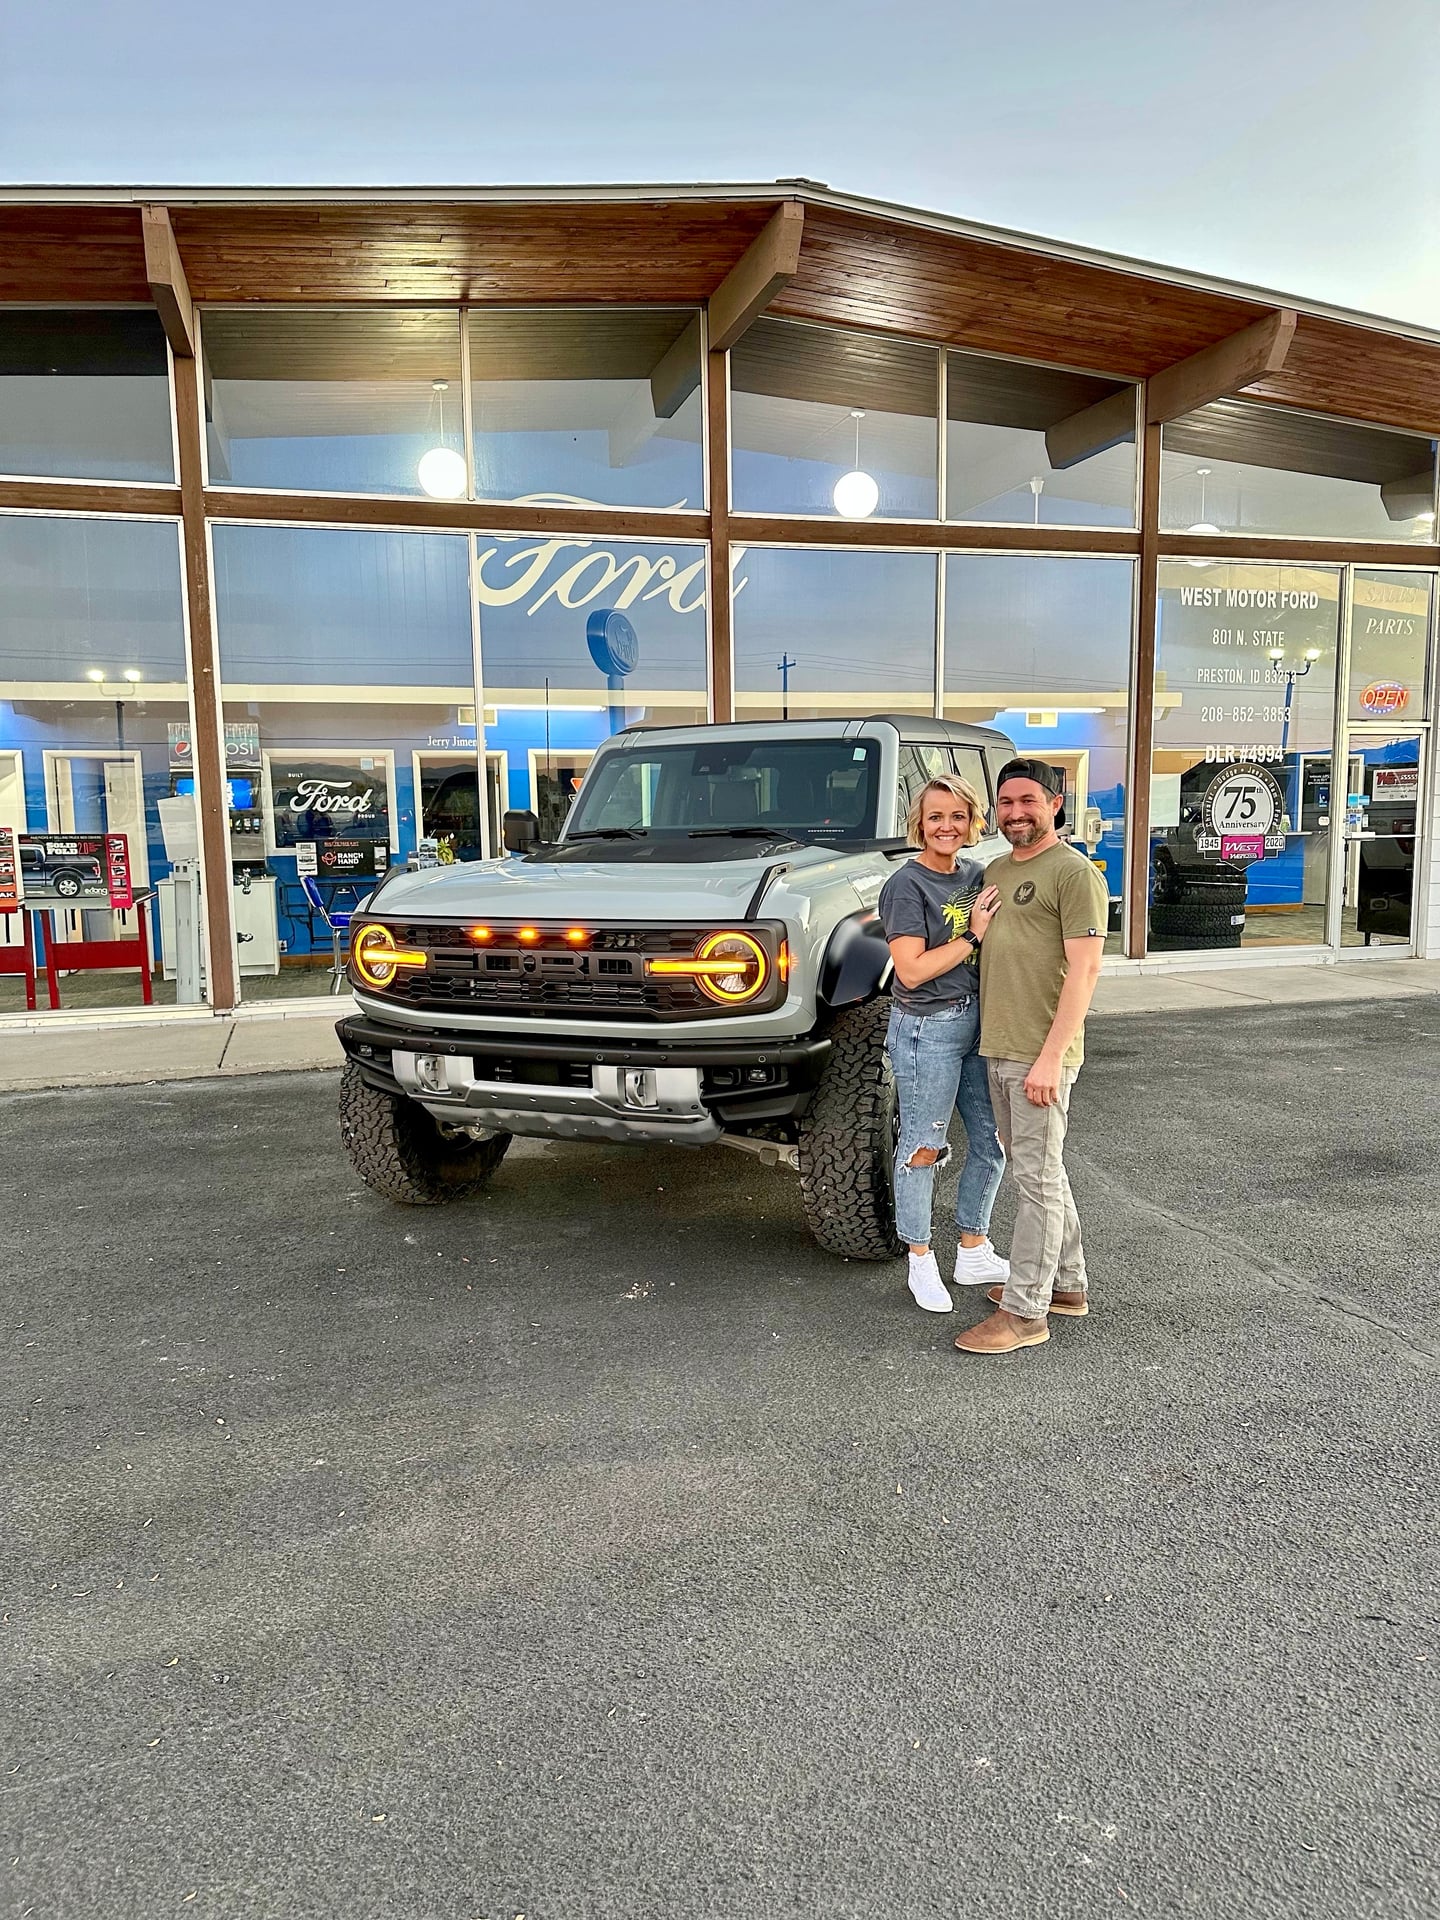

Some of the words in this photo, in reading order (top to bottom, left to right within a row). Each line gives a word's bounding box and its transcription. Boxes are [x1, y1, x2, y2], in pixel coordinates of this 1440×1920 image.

[477, 493, 749, 616] Ford
[1180, 587, 1222, 607] WEST
[1226, 588, 1277, 609] MOTOR
[1281, 590, 1319, 610] FORD
[1365, 617, 1415, 635] PARTS
[1212, 628, 1232, 645] 801
[1236, 630, 1247, 646] N.
[1252, 630, 1285, 647] STATE
[1250, 669, 1260, 683] ID
[1264, 669, 1297, 684] 83263
[1363, 689, 1408, 708] OPEN
[1201, 706, 1291, 722] 208-852-3853
[427, 735, 450, 749] Jerry
[452, 735, 488, 747] Jimenz
[1205, 745, 1236, 764] DLR
[1239, 744, 1284, 764] #4994
[1217, 767, 1238, 784] Dodge
[289, 779, 373, 813] Ford
[1219, 820, 1266, 829] Anniversary
[1200, 838, 1219, 849] 1945
[1265, 837, 1283, 847] 2020
[428, 947, 648, 982] FORD
